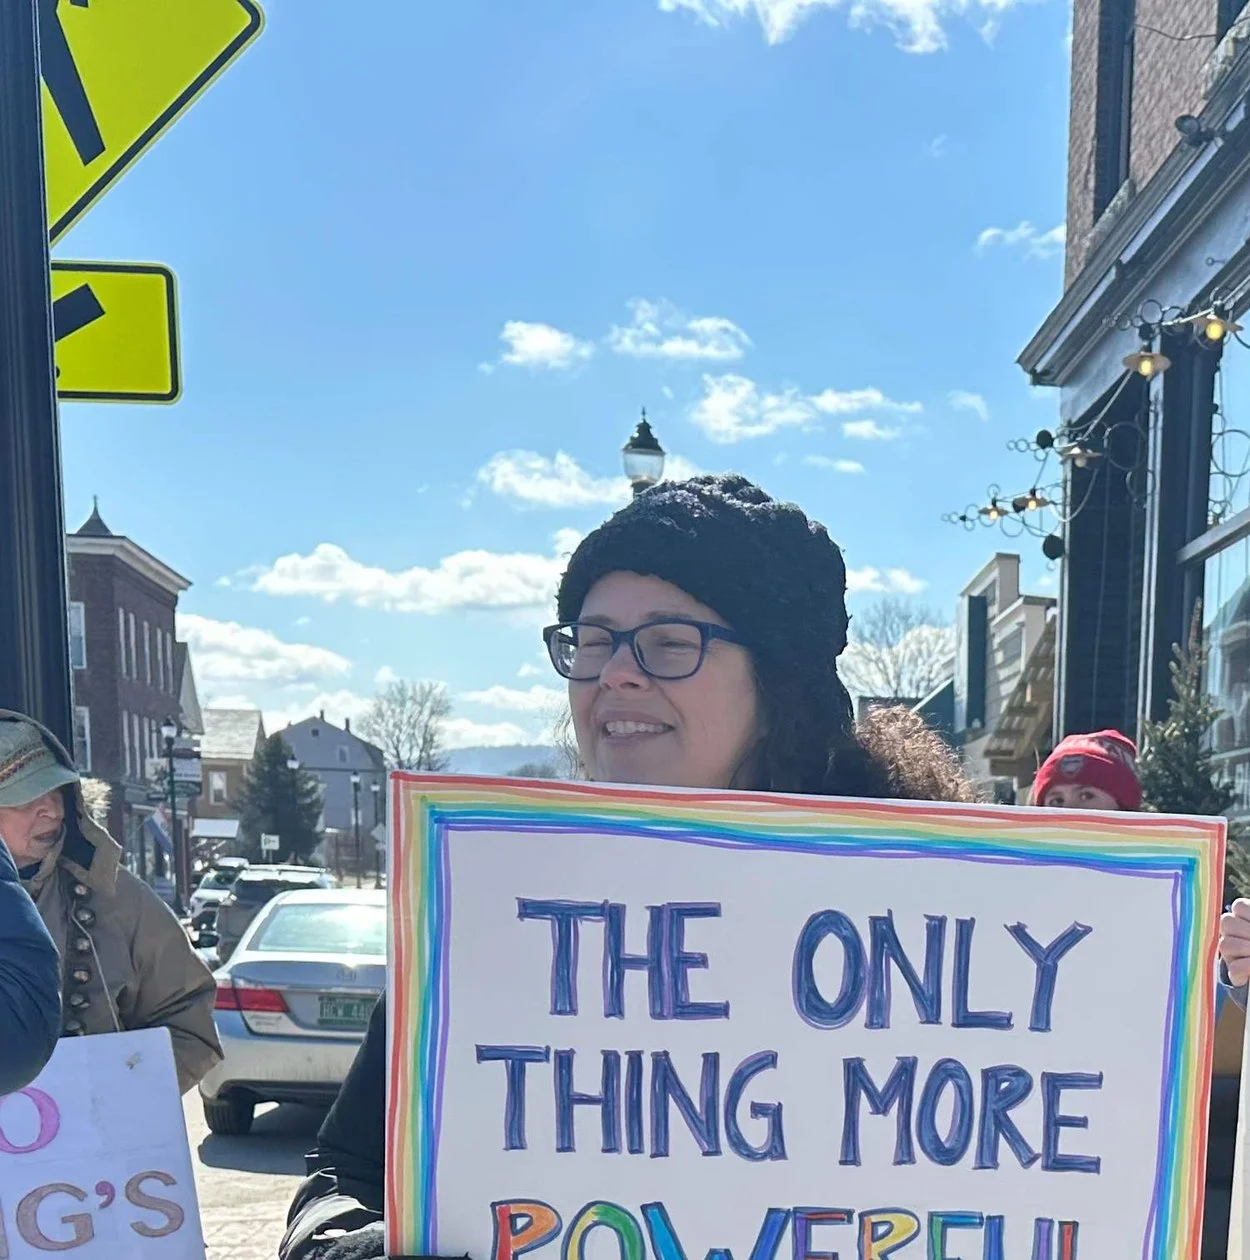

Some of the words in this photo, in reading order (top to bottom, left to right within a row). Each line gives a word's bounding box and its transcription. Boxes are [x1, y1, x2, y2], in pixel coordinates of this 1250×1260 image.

[516, 898, 730, 1019] THE
[792, 908, 1092, 1032] ONLY
[475, 1044, 788, 1161] THING
[839, 1056, 1104, 1173] MORE
